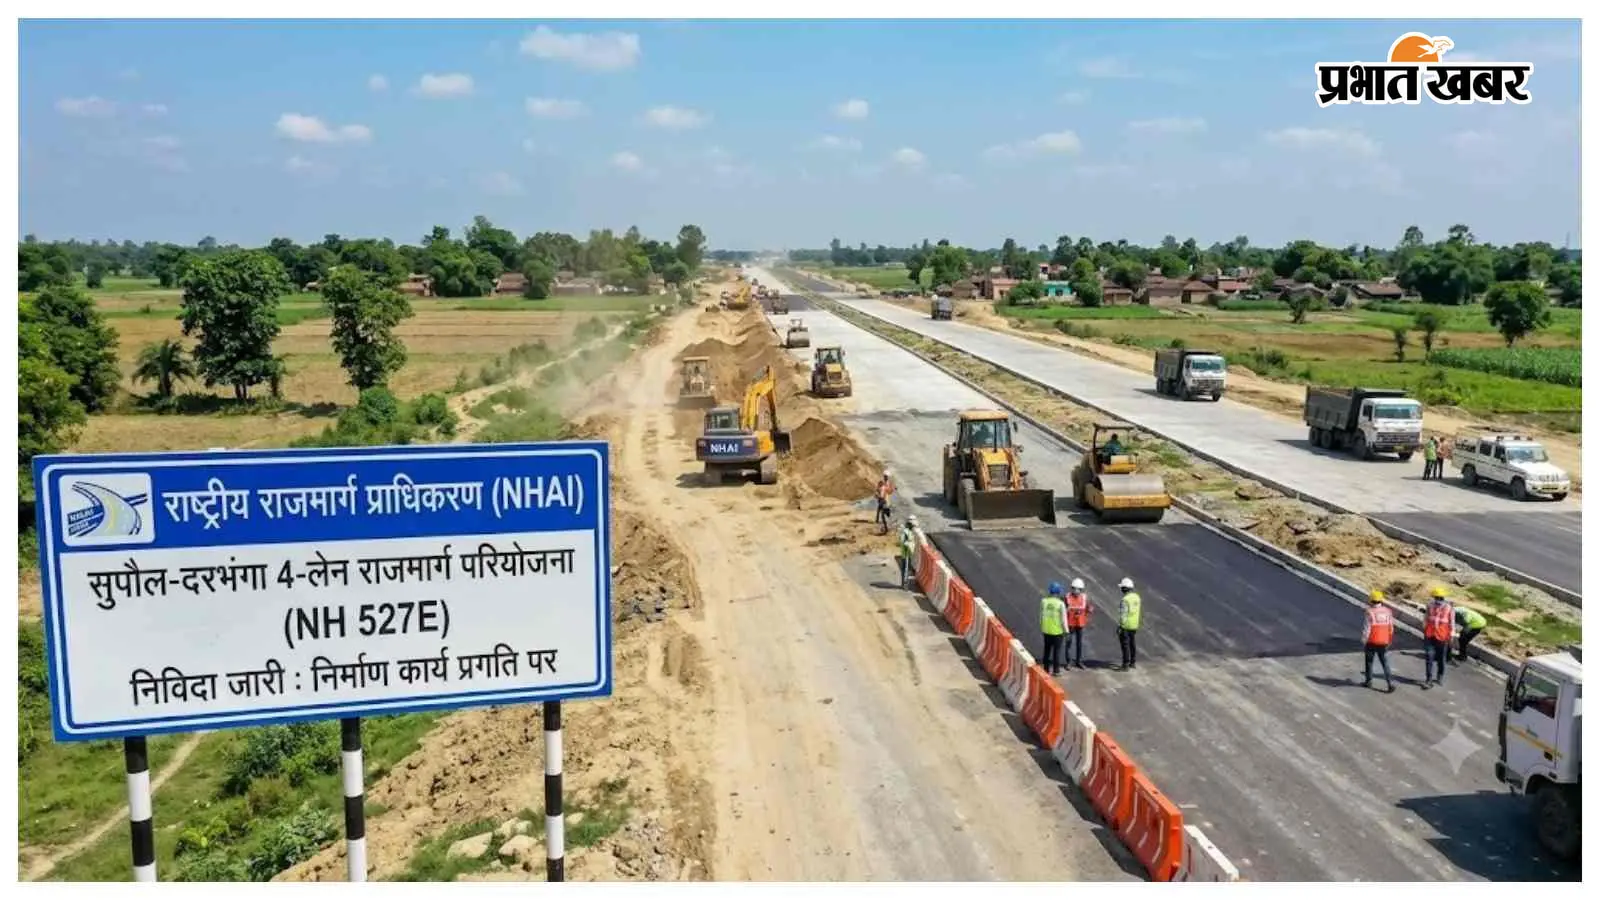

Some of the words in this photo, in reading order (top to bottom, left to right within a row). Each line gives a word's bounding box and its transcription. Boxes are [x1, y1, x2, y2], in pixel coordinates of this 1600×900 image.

[710, 443, 739, 453] NHAI
[161, 477, 250, 530] राष्ट्रीय
[257, 473, 359, 519] राजमार्ग
[364, 472, 484, 515] प्राधिकरण
[492, 473, 584, 519] (NHAI)
[277, 550, 350, 590] 4-लेन
[357, 544, 453, 585] राजमार्ग
[459, 541, 576, 579] परियोजना
[284, 605, 346, 650] (NH
[358, 599, 450, 640] 527E)
[129, 666, 218, 706] निविदा
[225, 658, 286, 697] जारी
[310, 652, 390, 693] निर्माण
[396, 646, 450, 685] कार्य
[456, 642, 520, 681] प्रगति
[526, 648, 559, 674] पर
